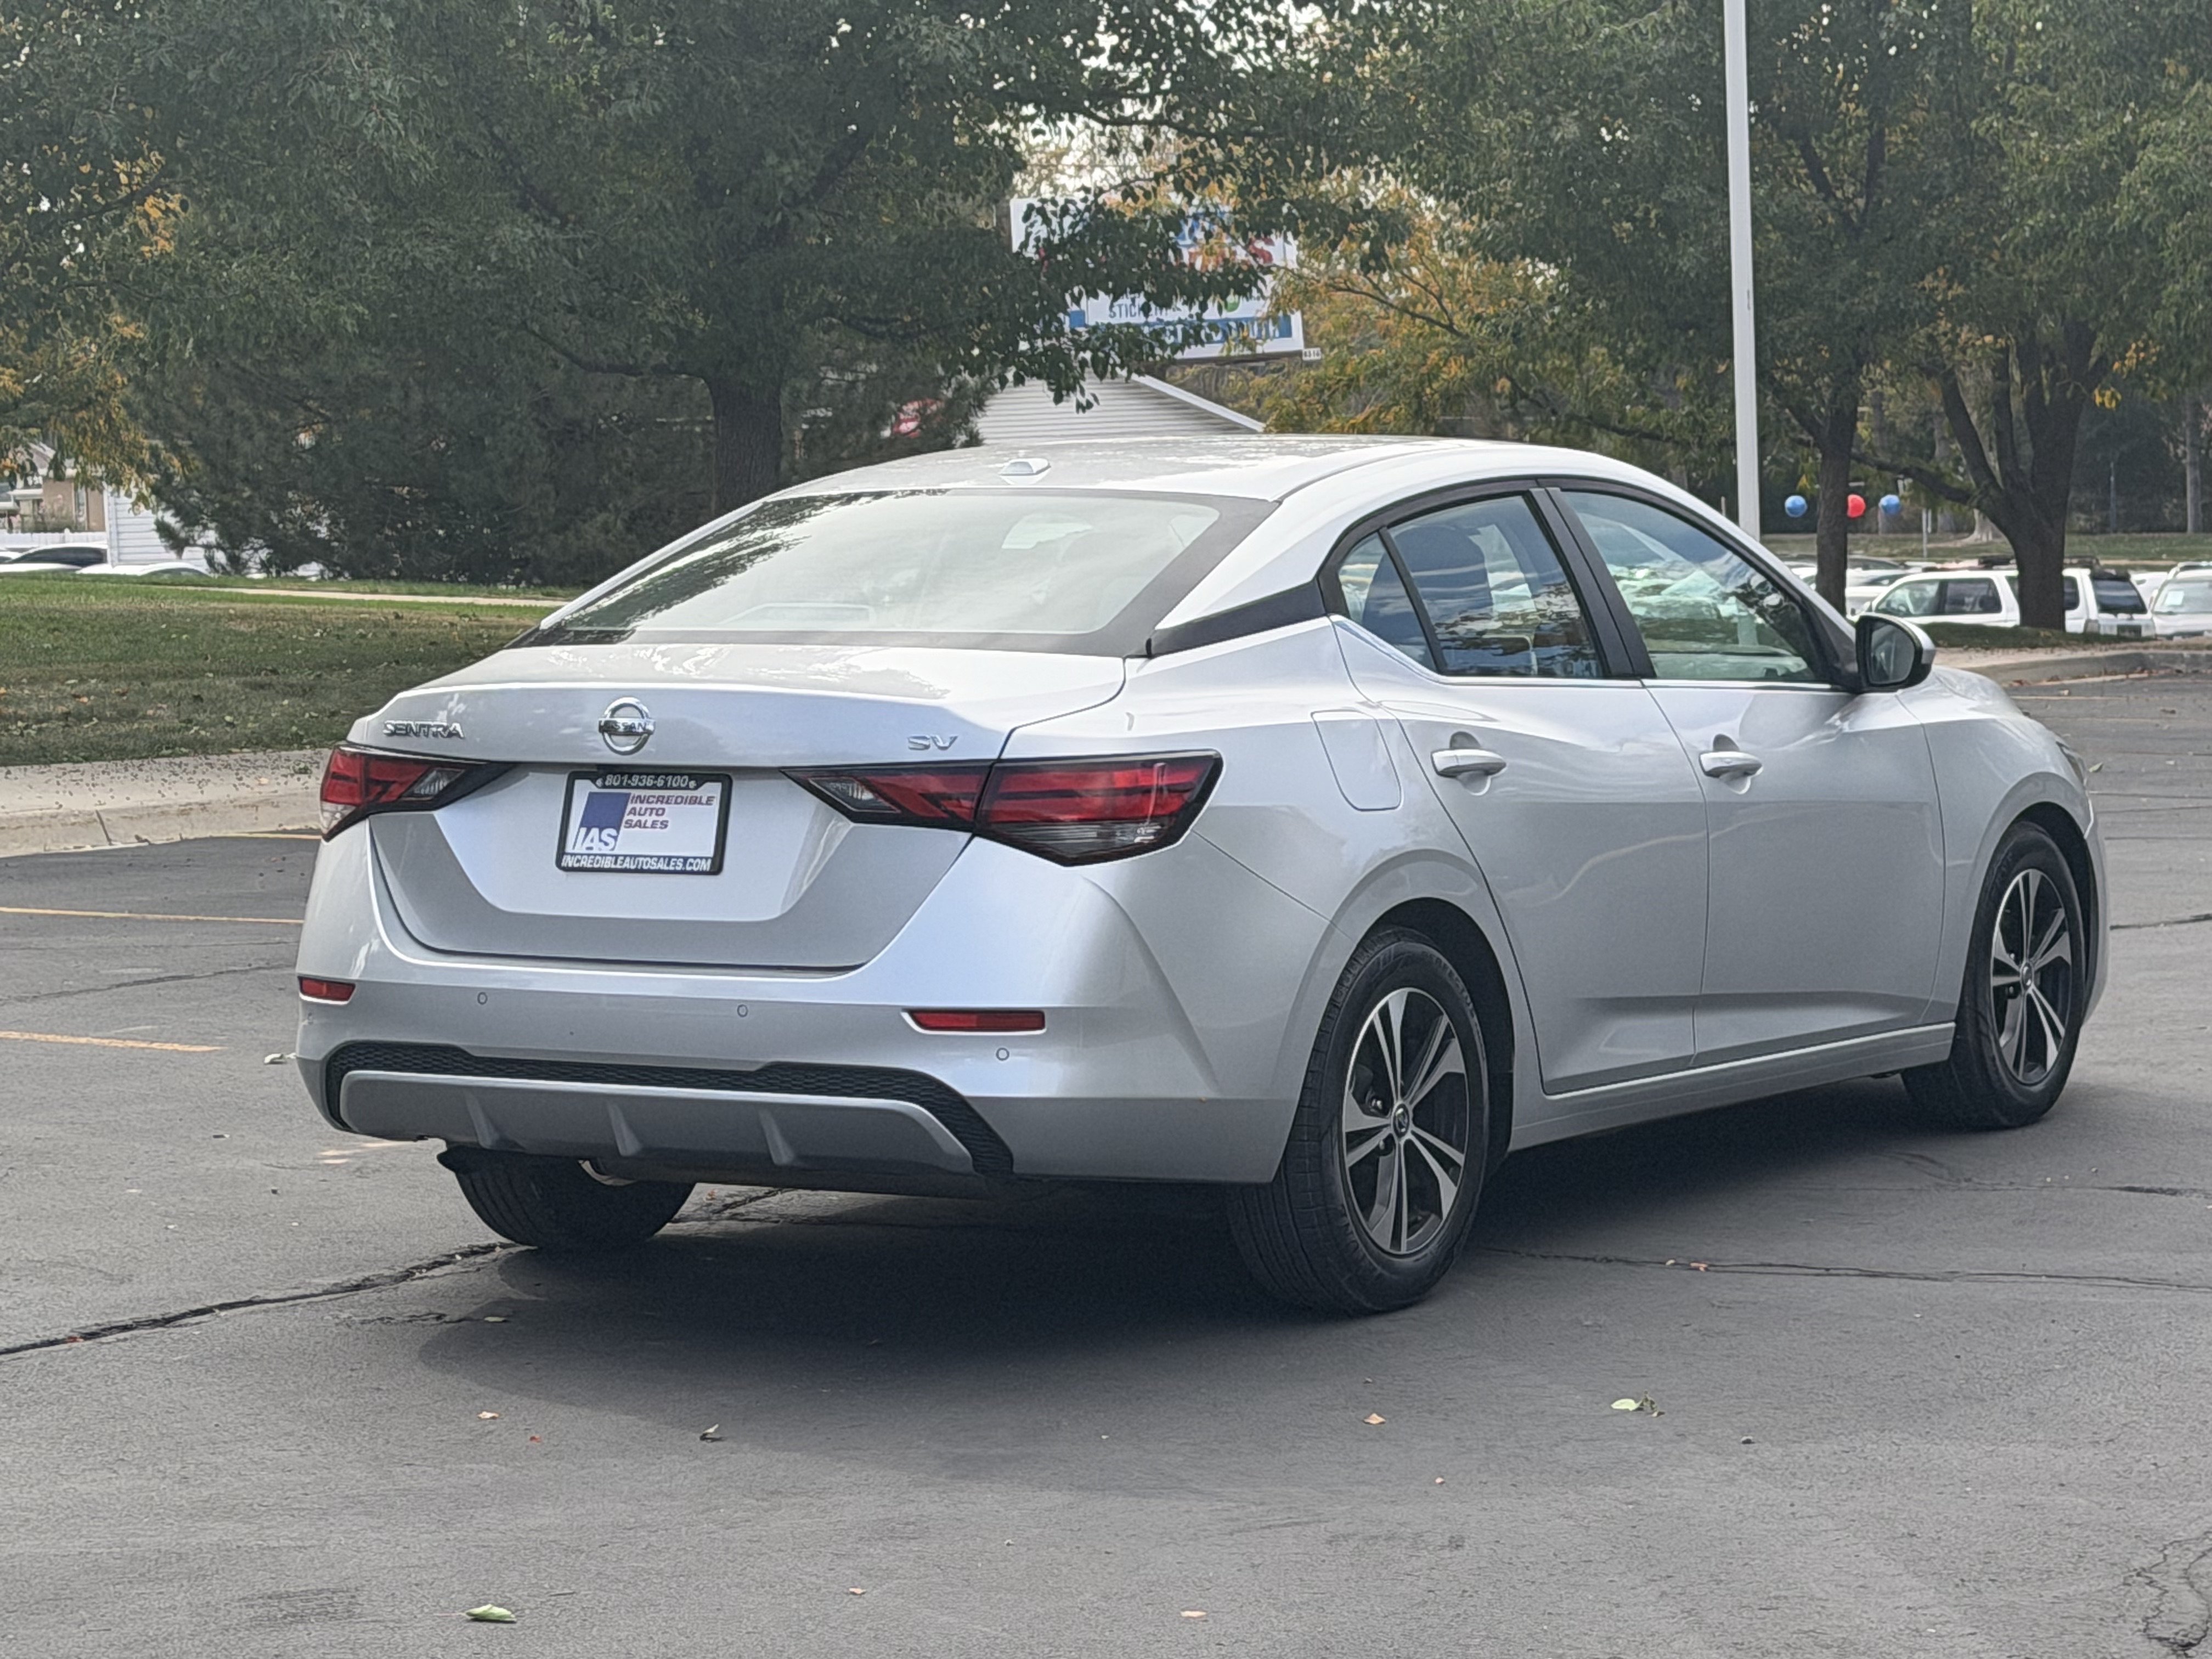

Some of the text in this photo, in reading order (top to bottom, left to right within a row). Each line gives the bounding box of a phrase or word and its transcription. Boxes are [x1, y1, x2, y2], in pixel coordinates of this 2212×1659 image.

[382, 720, 465, 739] SENTRA
[907, 735, 958, 751] SV
[630, 795, 715, 805] INCREDIBLE
[627, 807, 665, 817] AUTO
[623, 819, 669, 830] SALES
[575, 827, 618, 852] IAS
[561, 854, 712, 871] INCREDIBLEAUTOSALES.COM
